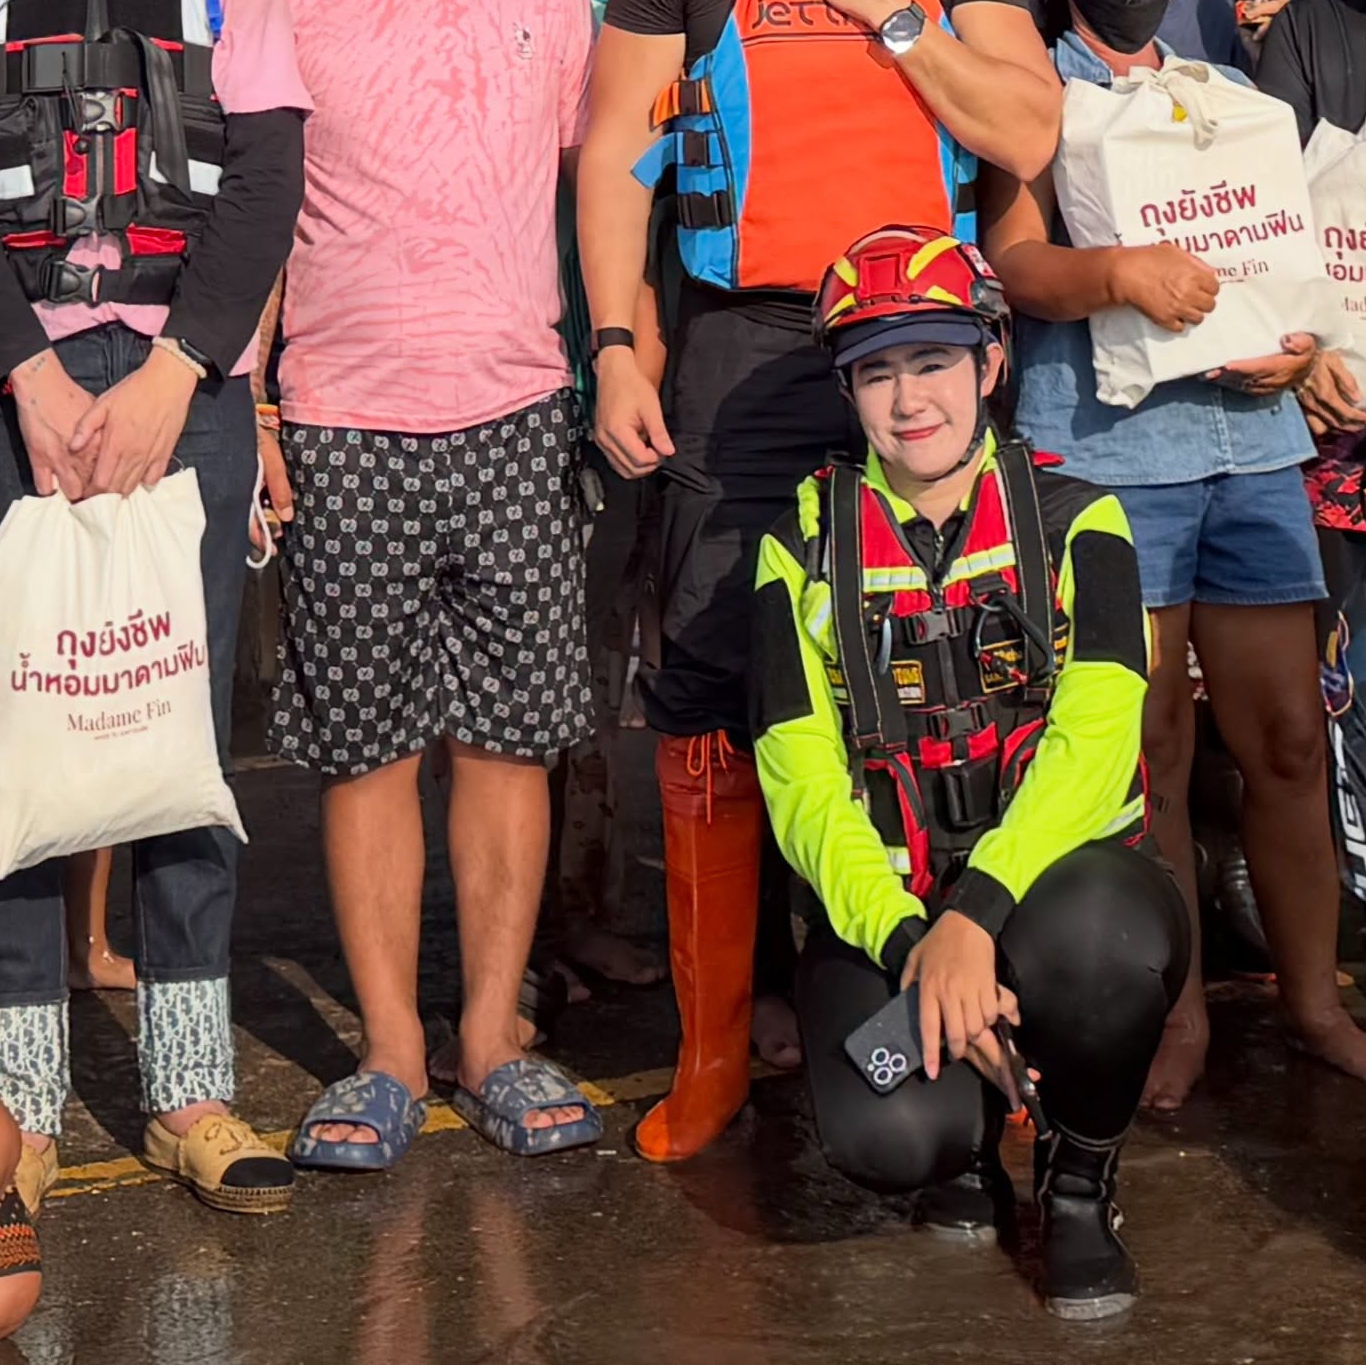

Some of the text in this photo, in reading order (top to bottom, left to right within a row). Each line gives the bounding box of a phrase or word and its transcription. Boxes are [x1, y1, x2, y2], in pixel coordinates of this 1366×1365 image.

[1140, 180, 1257, 236] ถุงยังชีพ
[1242, 258, 1269, 278] Fin
[56, 609, 171, 670] ถุงยังชีพ
[67, 698, 172, 732] Madame Fin
